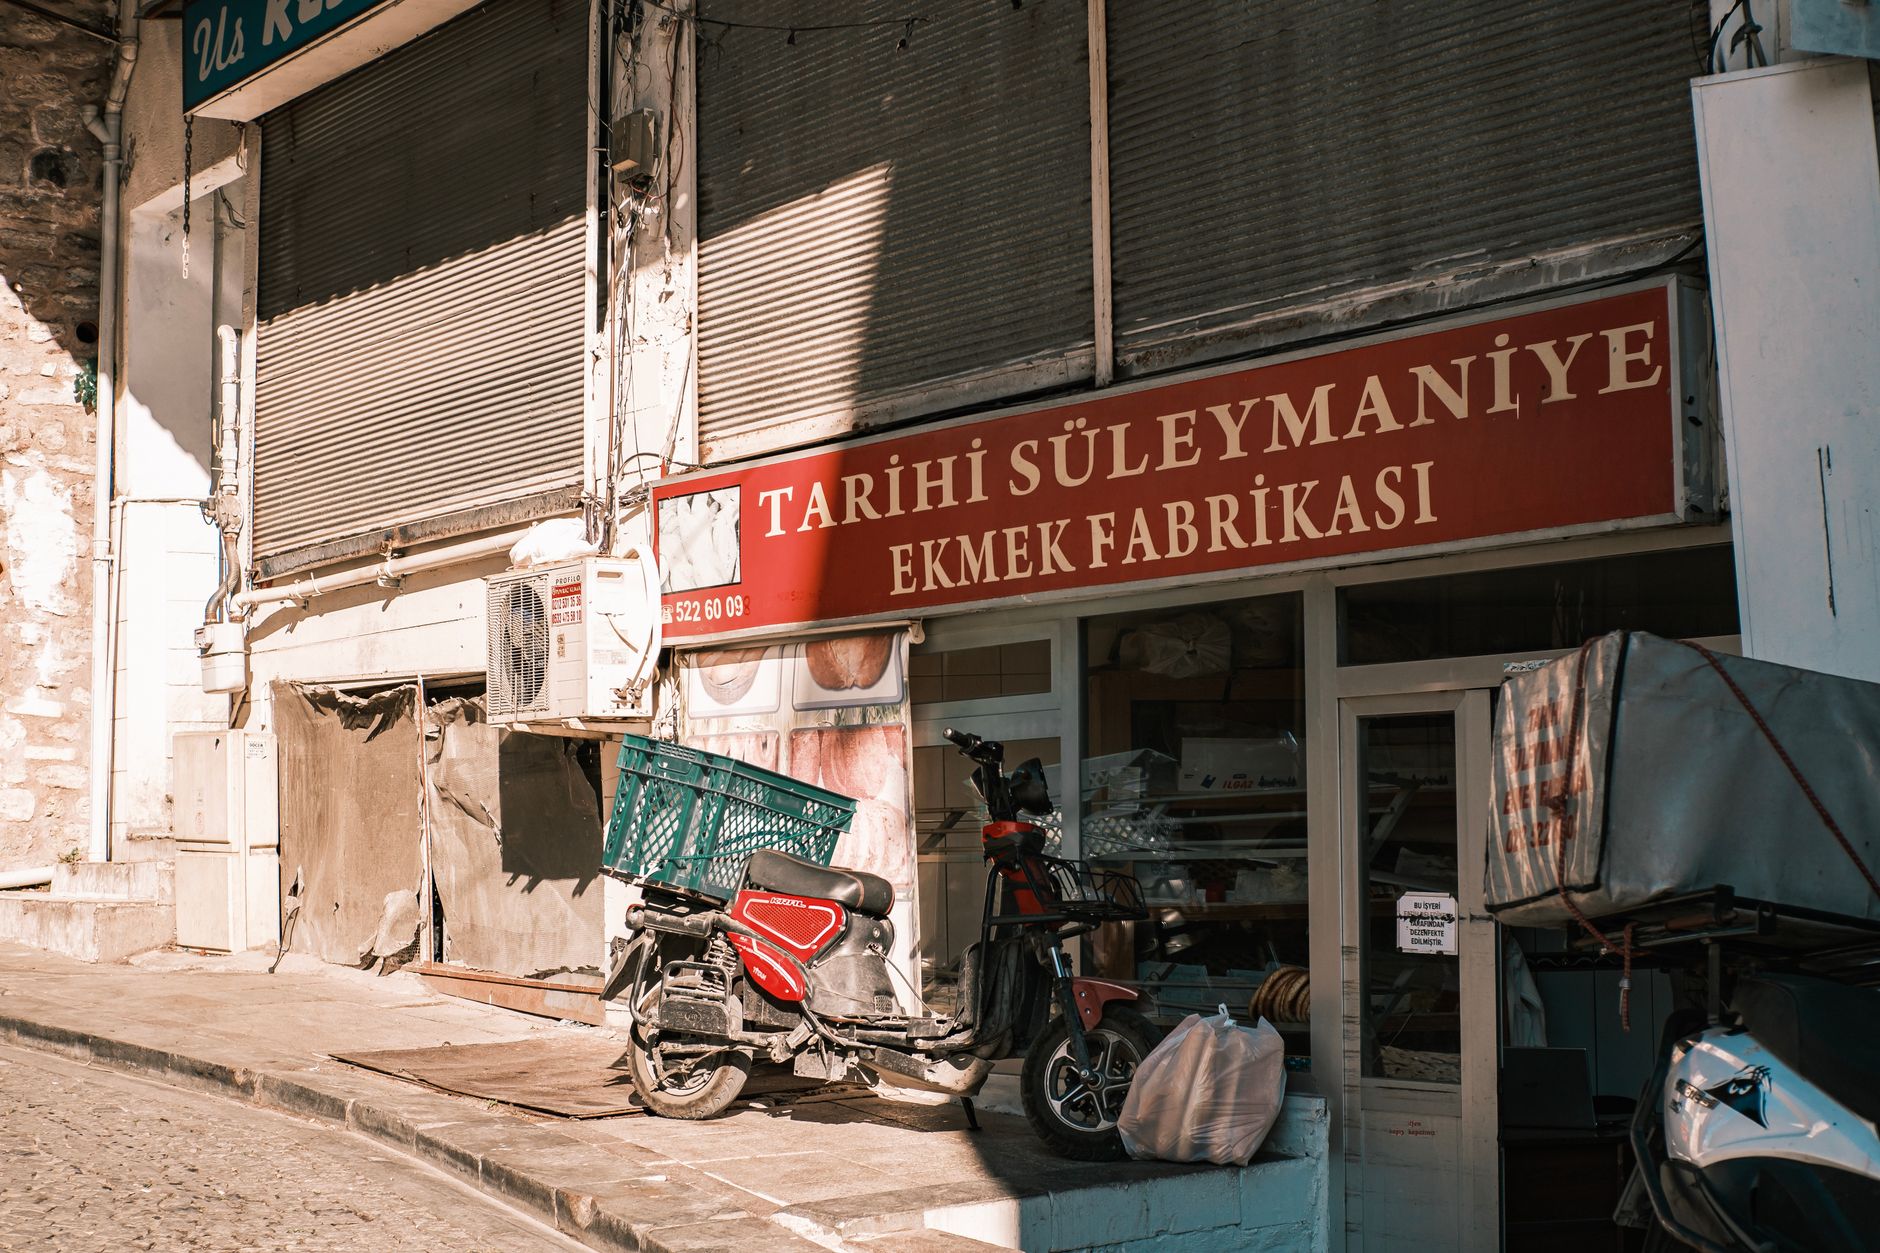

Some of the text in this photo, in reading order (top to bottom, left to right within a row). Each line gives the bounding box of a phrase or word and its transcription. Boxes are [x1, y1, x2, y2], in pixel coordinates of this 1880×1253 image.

[758, 320, 1663, 538] TARİHİ SÜLEYMANİYE
[889, 460, 1438, 597] EKMEK FABRİKASI
[676, 600, 702, 622] 522
[704, 597, 722, 620] 60
[1410, 929, 1444, 937] DEZENFEKTE
